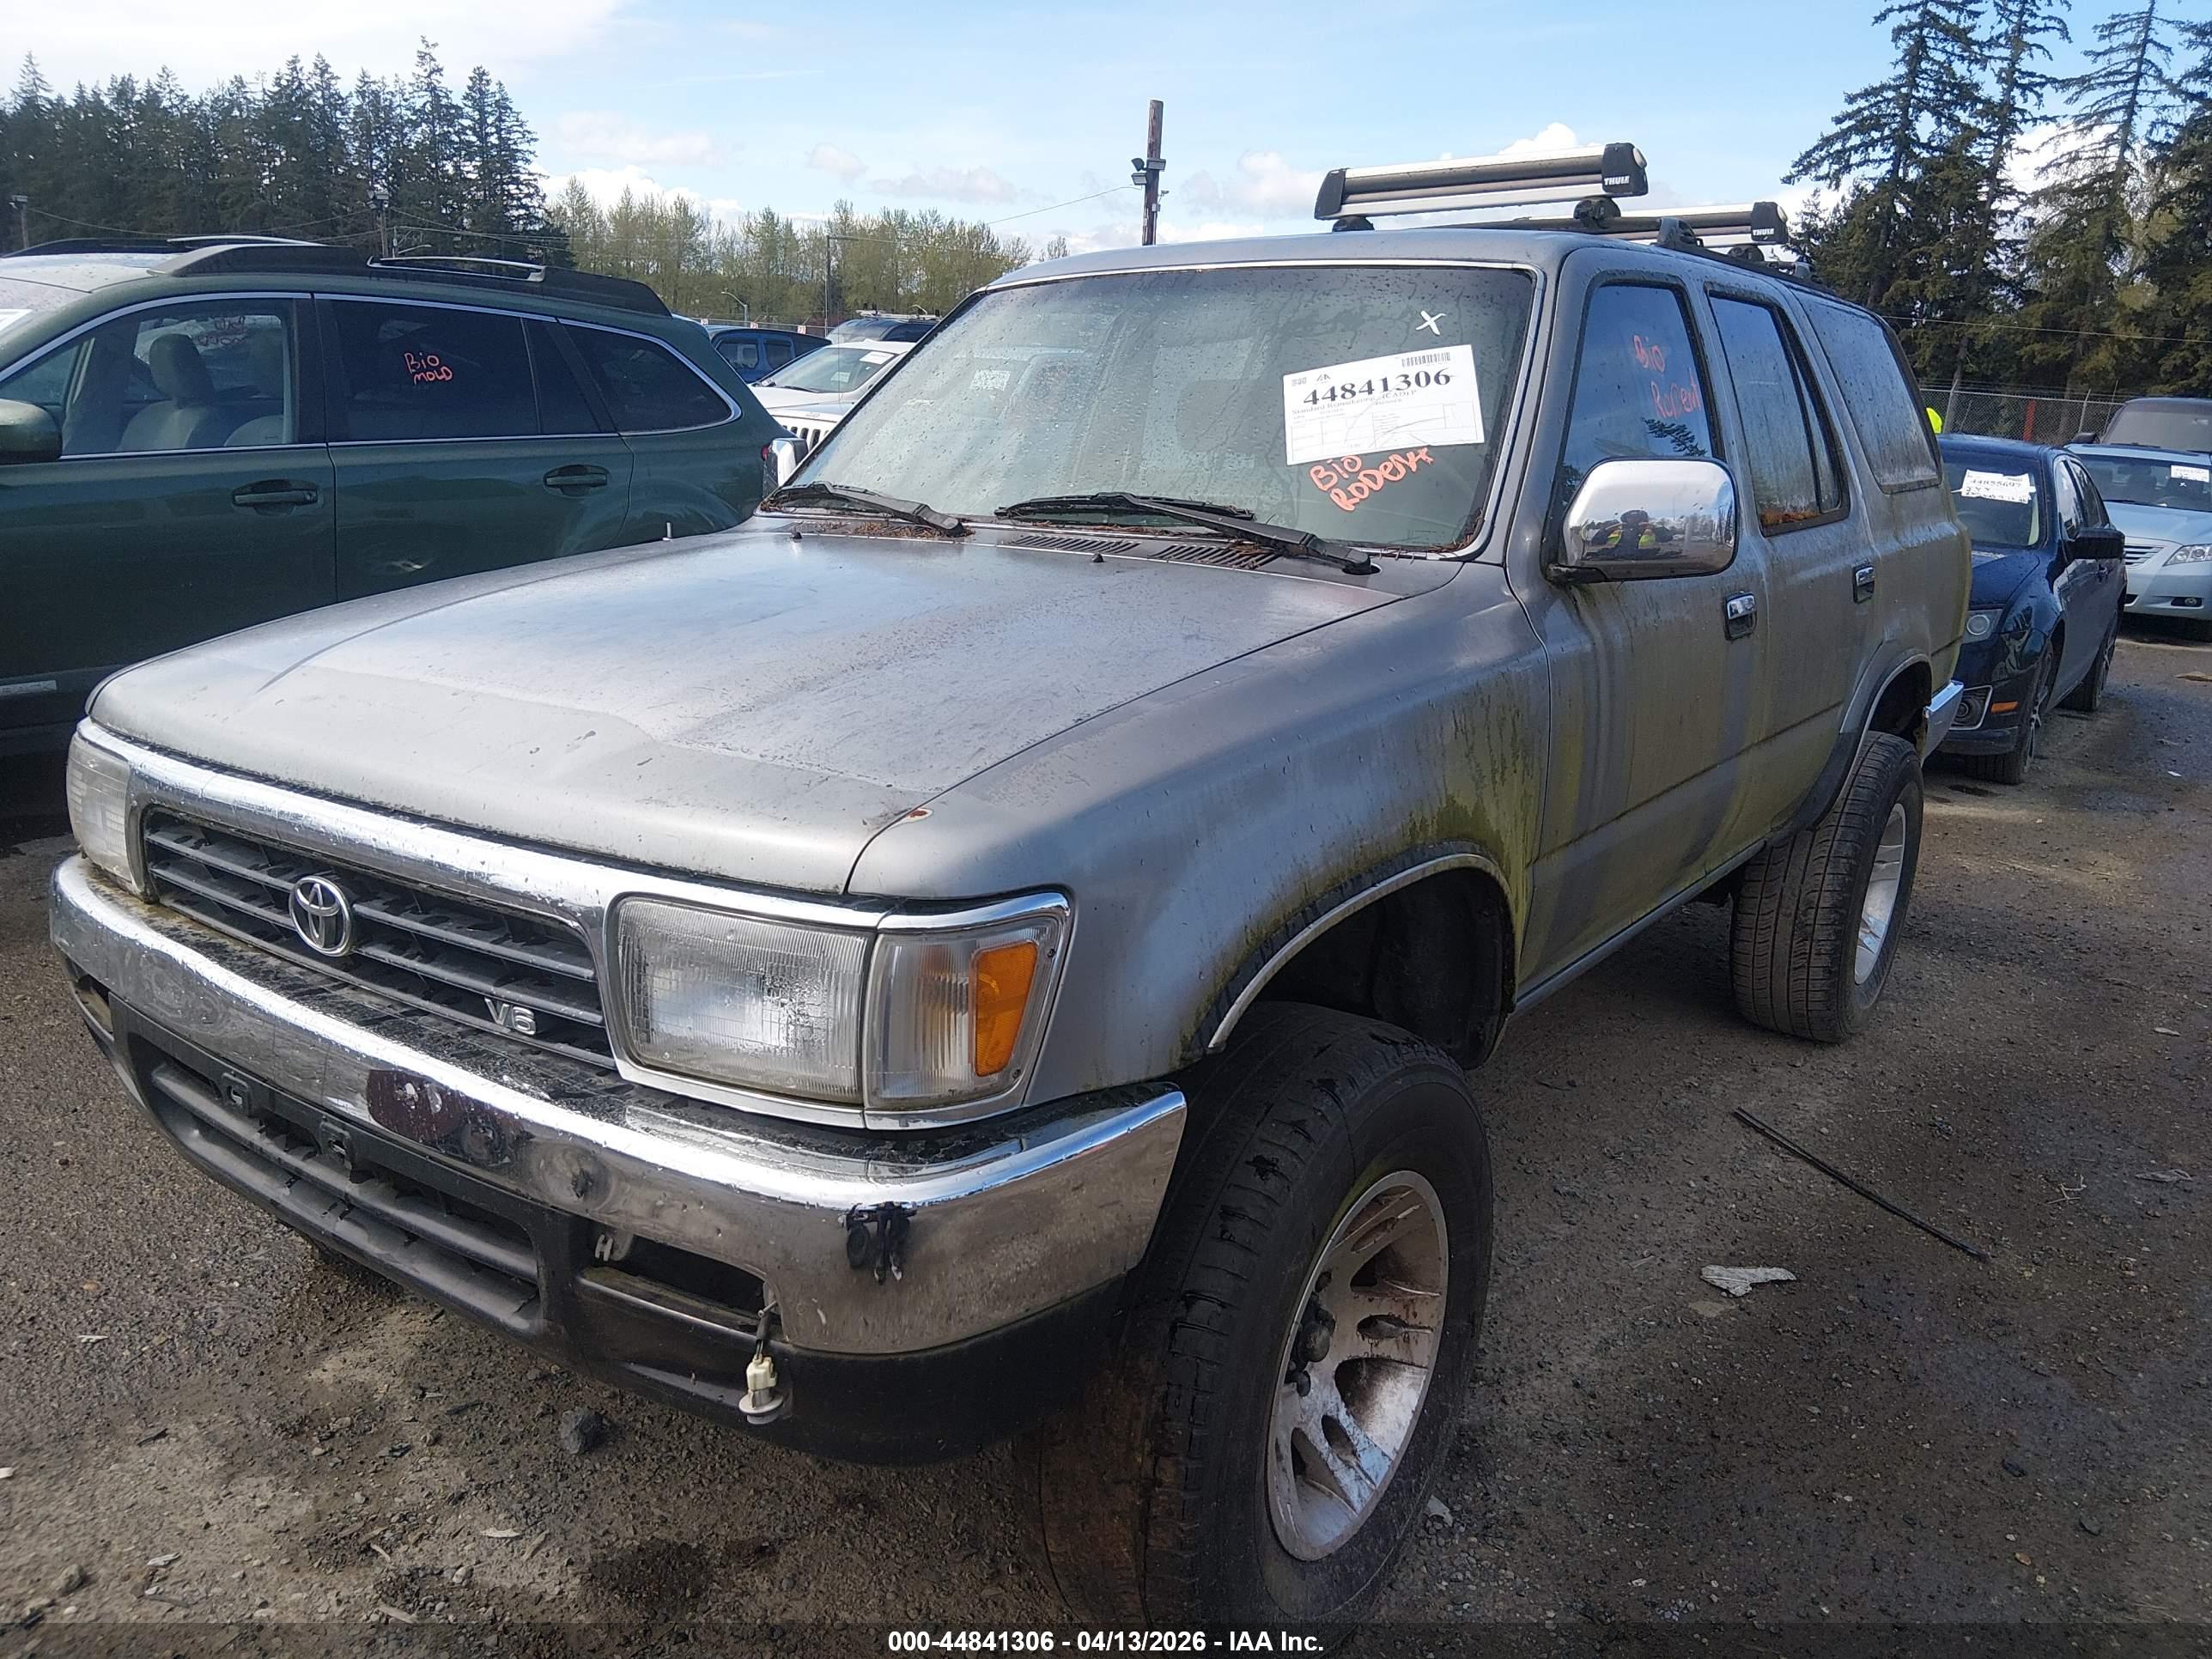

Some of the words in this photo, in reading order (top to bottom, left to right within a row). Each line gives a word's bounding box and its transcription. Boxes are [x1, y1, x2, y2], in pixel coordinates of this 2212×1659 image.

[1604, 175, 1630, 185] THULE
[1304, 368, 1451, 405] 44841306
[484, 997, 537, 1035] V6
